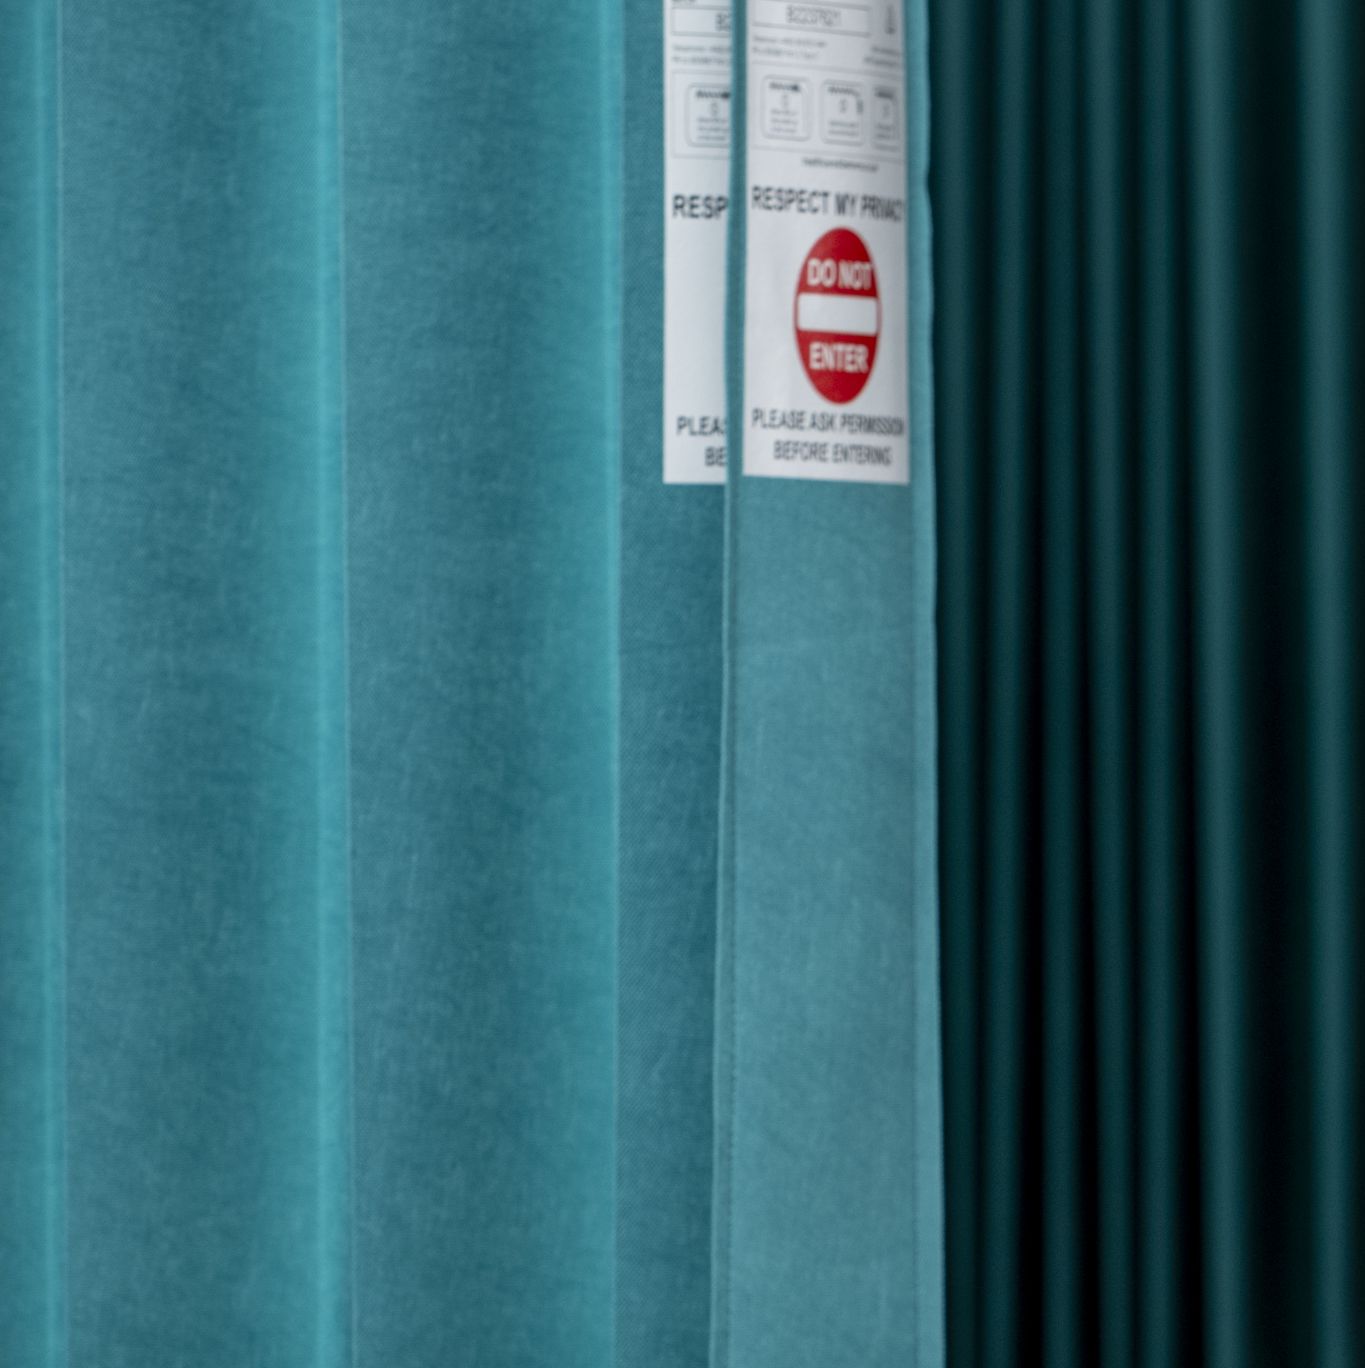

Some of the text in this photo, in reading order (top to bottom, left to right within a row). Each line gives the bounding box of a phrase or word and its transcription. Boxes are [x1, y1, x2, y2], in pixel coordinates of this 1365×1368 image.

[752, 186, 829, 215] RESPECT
[835, 192, 858, 216] MY
[807, 258, 873, 290] DO NOT
[809, 341, 869, 373] ENTER
[676, 415, 727, 436] PLEA
[752, 408, 806, 430] PLEASE
[809, 412, 836, 431] ASK
[773, 440, 892, 466] BEFORE ENTERING
